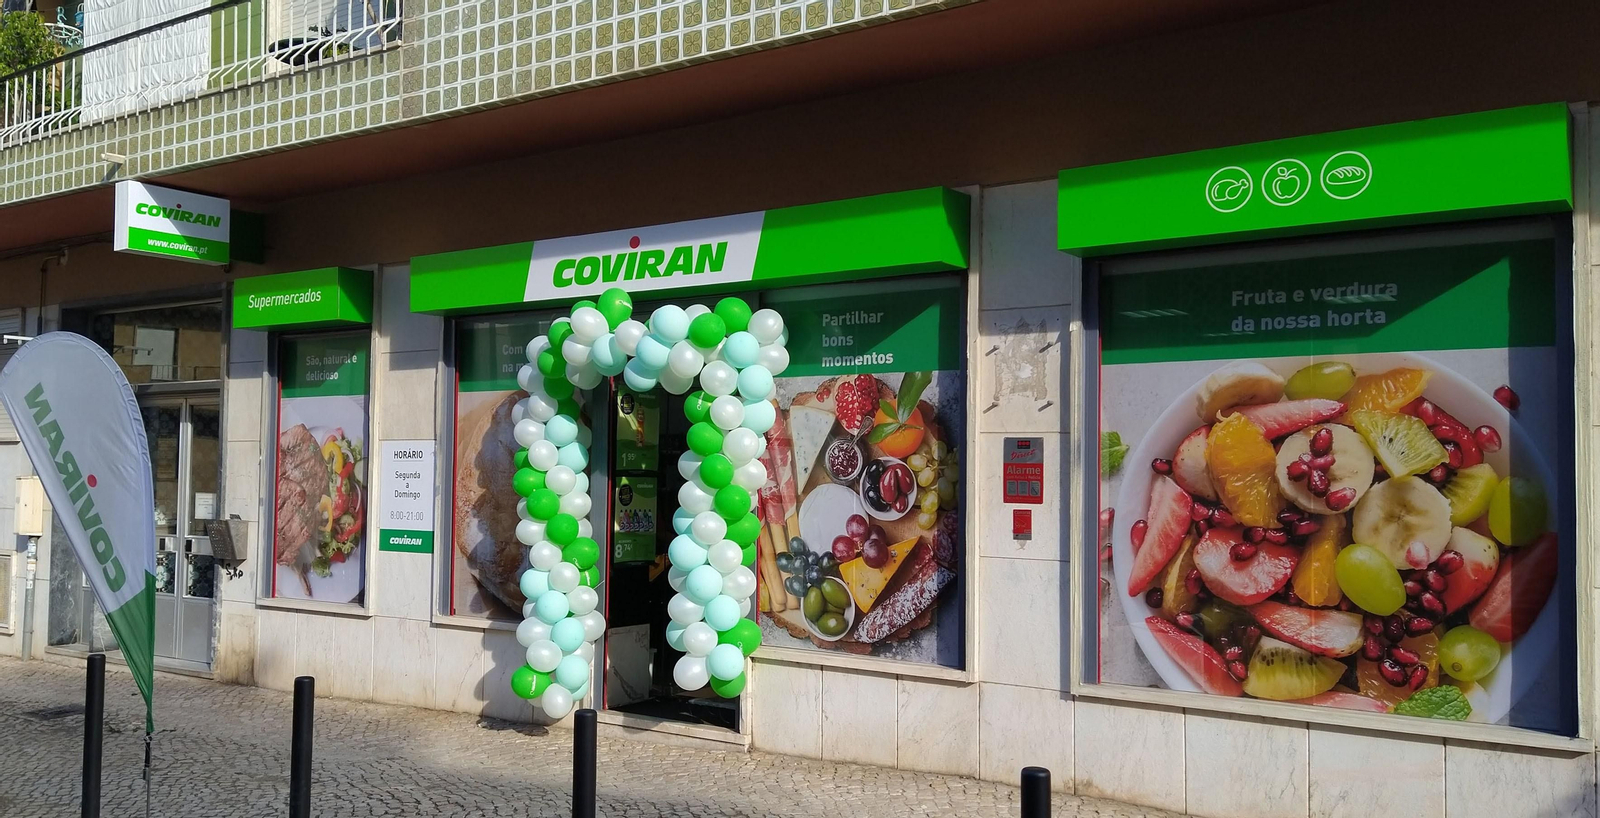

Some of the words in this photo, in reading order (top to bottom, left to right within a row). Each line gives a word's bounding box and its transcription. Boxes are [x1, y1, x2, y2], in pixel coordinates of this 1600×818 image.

[135, 203, 221, 227] COVIRAN
[147, 238, 208, 255] www.coviran.pt
[552, 236, 728, 288] COVIRAN
[248, 289, 322, 309] Supermercados
[1231, 289, 1287, 307] Fruta
[1292, 288, 1305, 303] e
[1310, 281, 1398, 302] verdura
[822, 311, 884, 327] Partilhar
[1231, 315, 1255, 333] da
[1261, 312, 1321, 331] nossa
[1327, 308, 1387, 327] horta
[822, 334, 854, 348] bons
[502, 344, 523, 356] Com
[305, 355, 322, 367] São,
[323, 353, 351, 365] natural
[352, 354, 358, 363] e
[821, 351, 894, 368] momentos
[502, 363, 514, 373] na
[305, 370, 339, 381] delicioso
[393, 448, 424, 460] HORÁRIO
[395, 470, 421, 481] Segunda
[1006, 464, 1041, 475] Alarme
[394, 490, 421, 500] Domingo
[389, 534, 422, 546] COVIRAN
